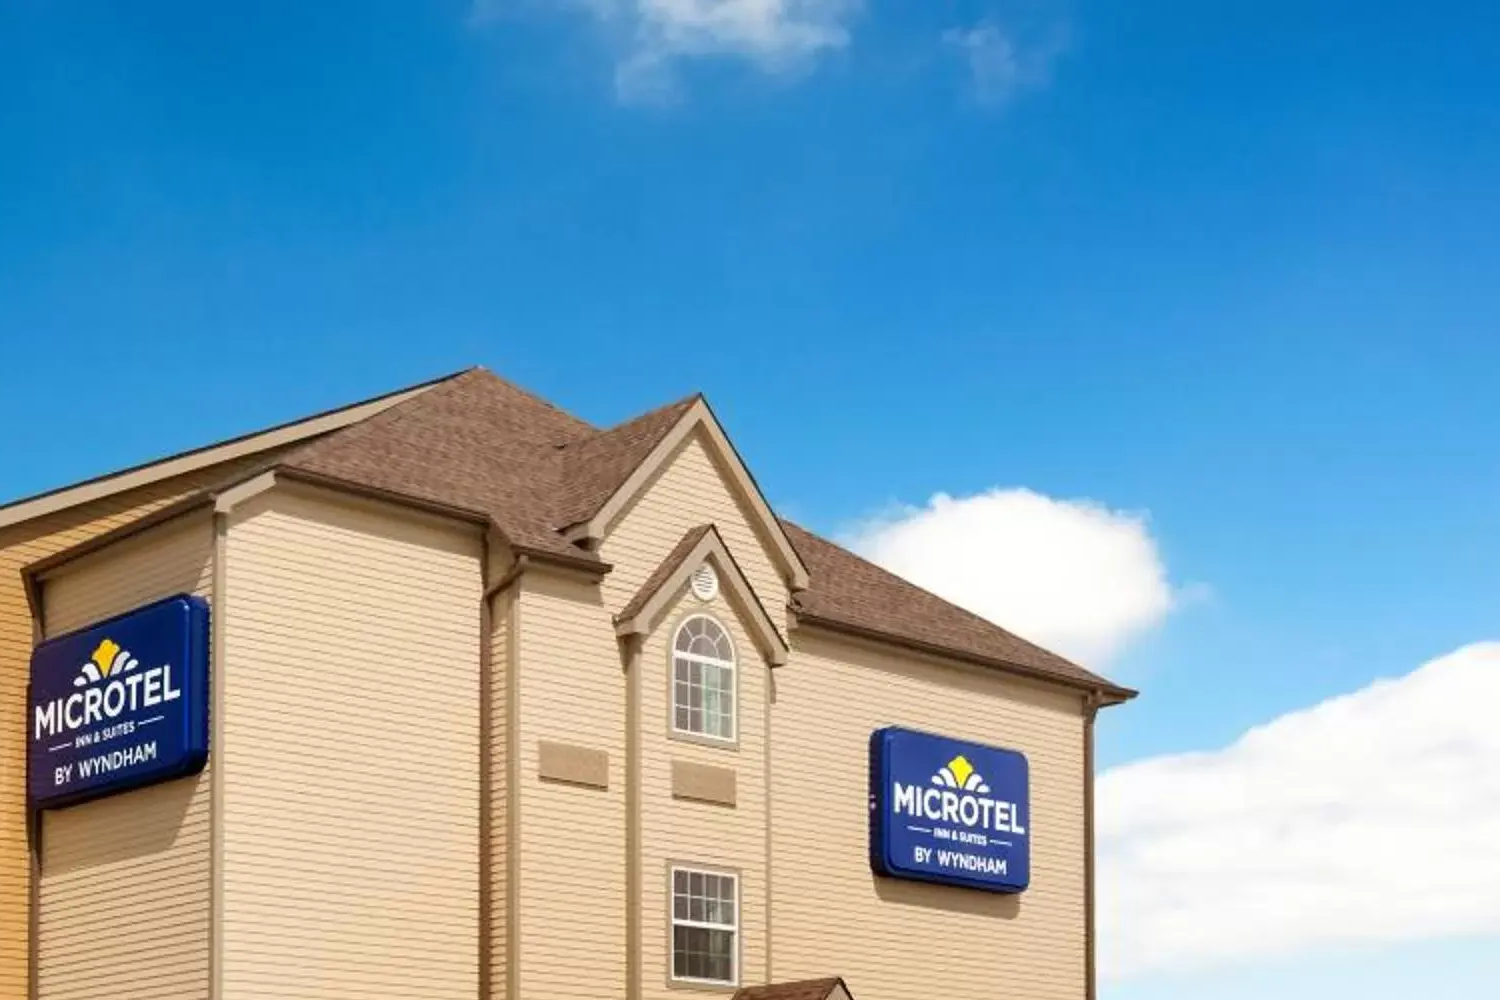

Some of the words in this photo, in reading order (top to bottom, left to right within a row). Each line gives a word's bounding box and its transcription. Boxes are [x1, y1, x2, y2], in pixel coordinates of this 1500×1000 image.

[35, 665, 181, 740] MICROTEL
[75, 734, 92, 748] INN
[94, 731, 101, 744] &
[102, 721, 135, 740] SUITES
[55, 763, 73, 785] BY
[78, 741, 157, 778] WYNDHAM
[894, 782, 1025, 834] MICROTEL
[933, 827, 951, 839] INN
[959, 831, 987, 846] SUITES
[915, 846, 932, 864] BY
[937, 849, 1007, 876] WYNDHAM
